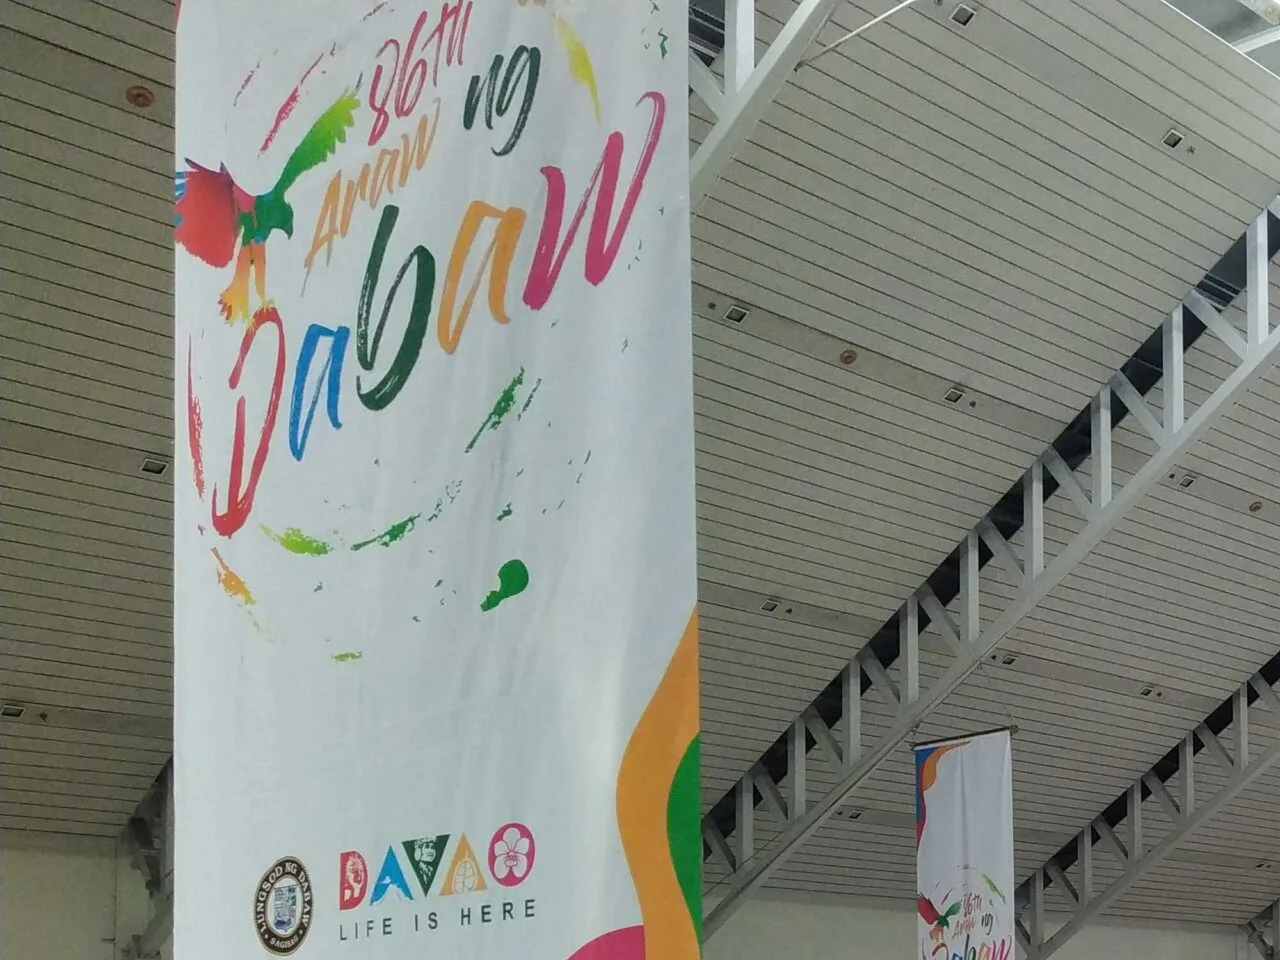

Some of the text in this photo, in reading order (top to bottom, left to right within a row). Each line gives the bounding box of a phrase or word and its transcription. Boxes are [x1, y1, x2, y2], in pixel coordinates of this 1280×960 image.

[302, 45, 541, 280] Araw ng
[211, 91, 665, 537] Dabaw
[339, 822, 536, 911] DAVAO
[339, 898, 536, 941] LIFE IS HERE
